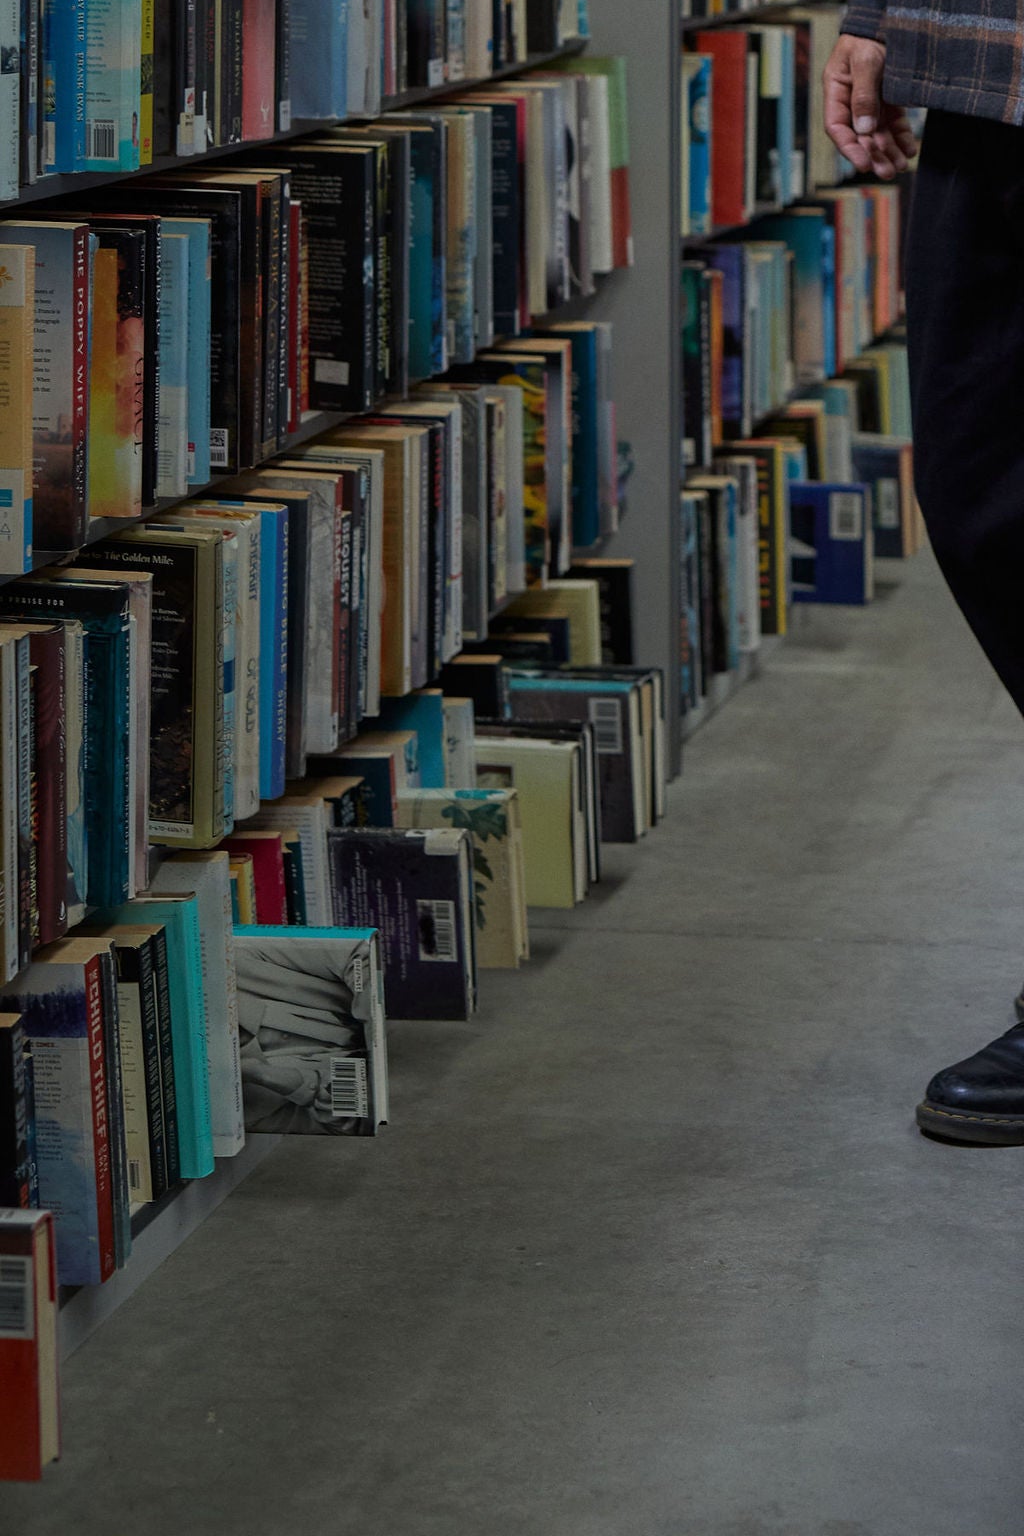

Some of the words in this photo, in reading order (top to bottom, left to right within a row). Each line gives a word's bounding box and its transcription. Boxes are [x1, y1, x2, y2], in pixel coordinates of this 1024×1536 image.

[77, 12, 85, 41] BLUE
[76, 52, 84, 88] FRANK
[76, 365, 84, 417] WIFE
[122, 552, 150, 564] Golden
[340, 520, 350, 604] BEQUEST
[21, 642, 29, 672] THE
[21, 678, 29, 727] BLACK
[21, 735, 29, 829] MONASTERY
[90, 980, 102, 1060] CHILD
[144, 993, 154, 1030] SMITH
[94, 1063, 107, 1138] THIEF
[97, 1150, 105, 1192] SMITH
